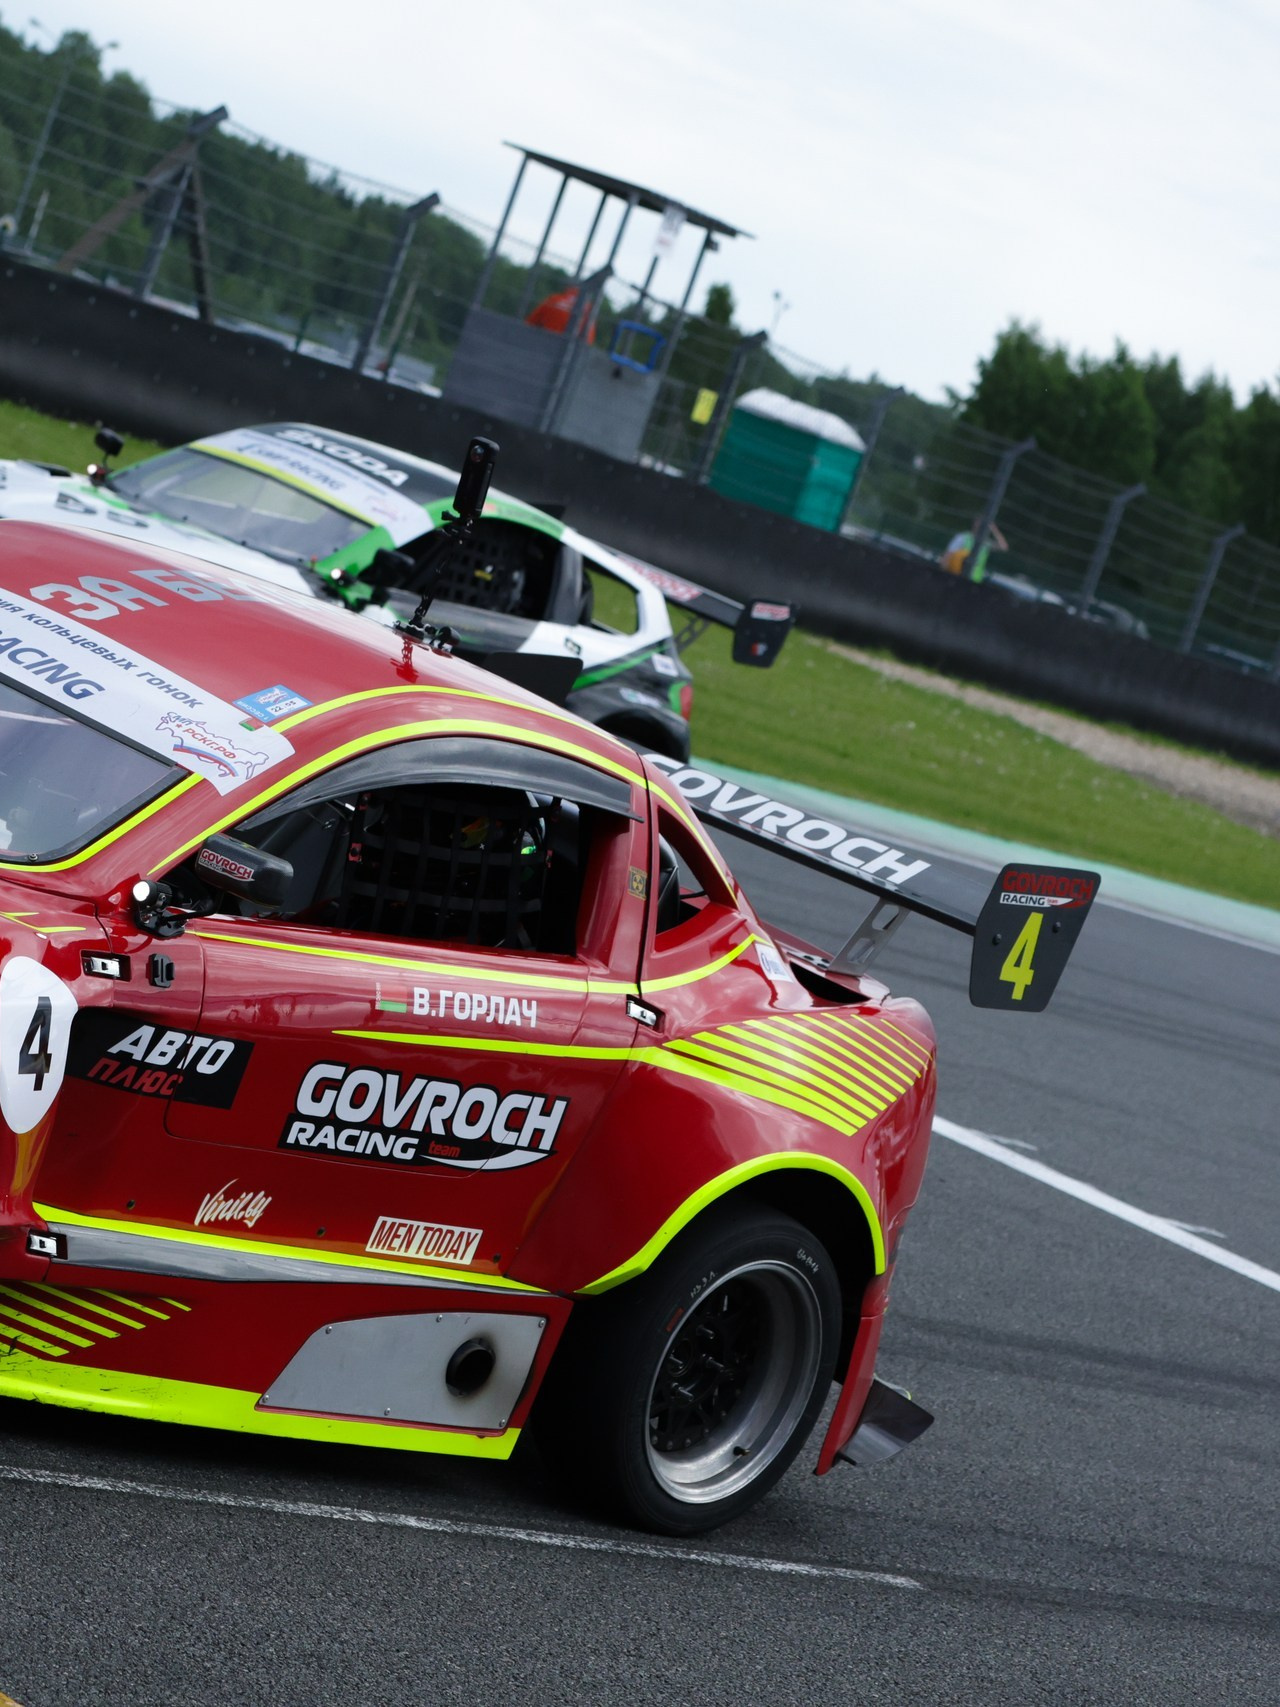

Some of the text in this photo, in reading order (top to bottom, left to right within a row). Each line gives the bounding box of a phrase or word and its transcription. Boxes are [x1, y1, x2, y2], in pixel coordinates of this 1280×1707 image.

[21, 612, 138, 670] кольцевых
[136, 671, 205, 709] гонок
[201, 850, 253, 879] GOVROCH
[1002, 870, 1095, 900] GOVROCH
[1001, 893, 1045, 906] RACING
[999, 911, 1044, 1000] 4
[413, 986, 537, 1028] В.ГОРЛАЧ
[18, 996, 51, 1091] 4
[107, 1024, 236, 1075] АВТО
[296, 1063, 567, 1151] GOVROCH
[287, 1121, 460, 1160] RACING team
[370, 1220, 480, 1261] MEN TODAY
